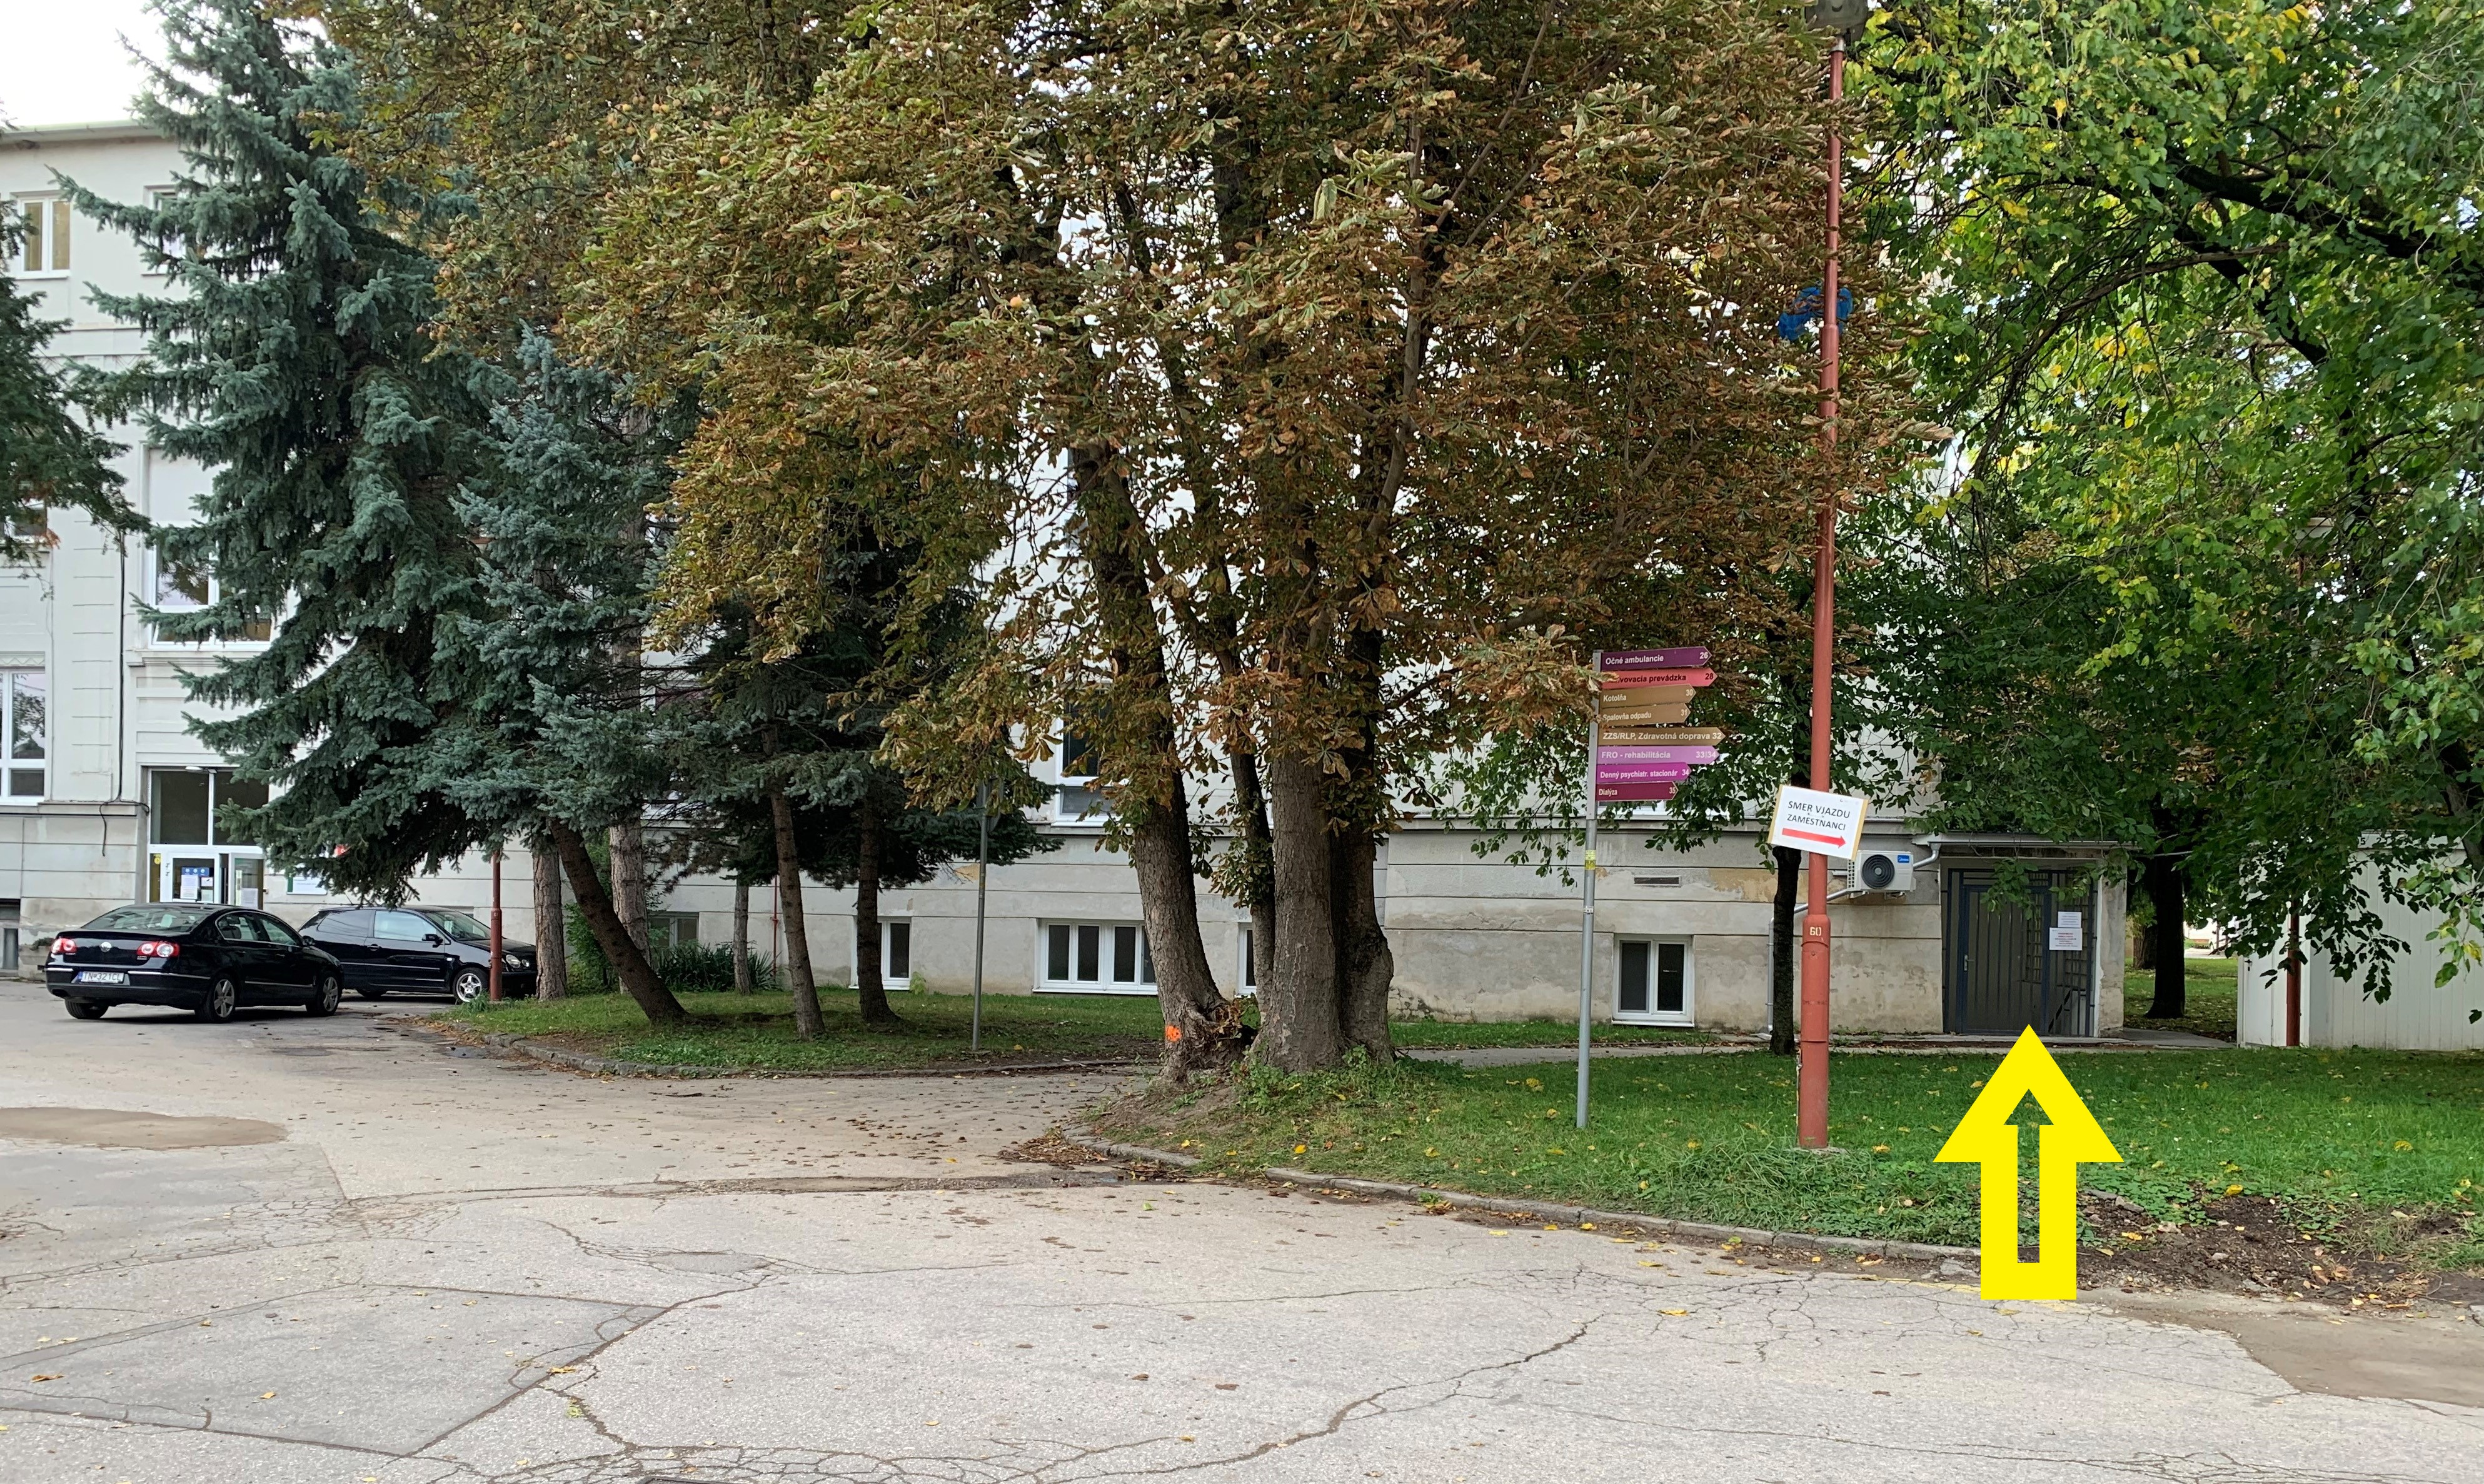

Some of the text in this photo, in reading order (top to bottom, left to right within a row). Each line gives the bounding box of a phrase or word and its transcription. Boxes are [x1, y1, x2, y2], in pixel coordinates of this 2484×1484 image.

[1625, 654, 1664, 664] ambulancie
[1649, 674, 1686, 683] prevádzka
[1603, 694, 1627, 702] Kotolňa
[1603, 713, 1629, 722] Spalovňa
[1630, 711, 1652, 720] odpadu
[1602, 732, 1637, 741] ZZS/RLP,
[1679, 732, 1711, 741] doprava
[1600, 771, 1619, 780] Denný
[1621, 771, 1649, 780] psychiatr.
[1599, 788, 1617, 797] Dialýza
[1788, 801, 1850, 818] SMER VJAZDU
[1787, 814, 1846, 831] ZAMESTNANCI
[1810, 926, 1822, 936] 60
[84, 972, 121, 981] TN 321CL
